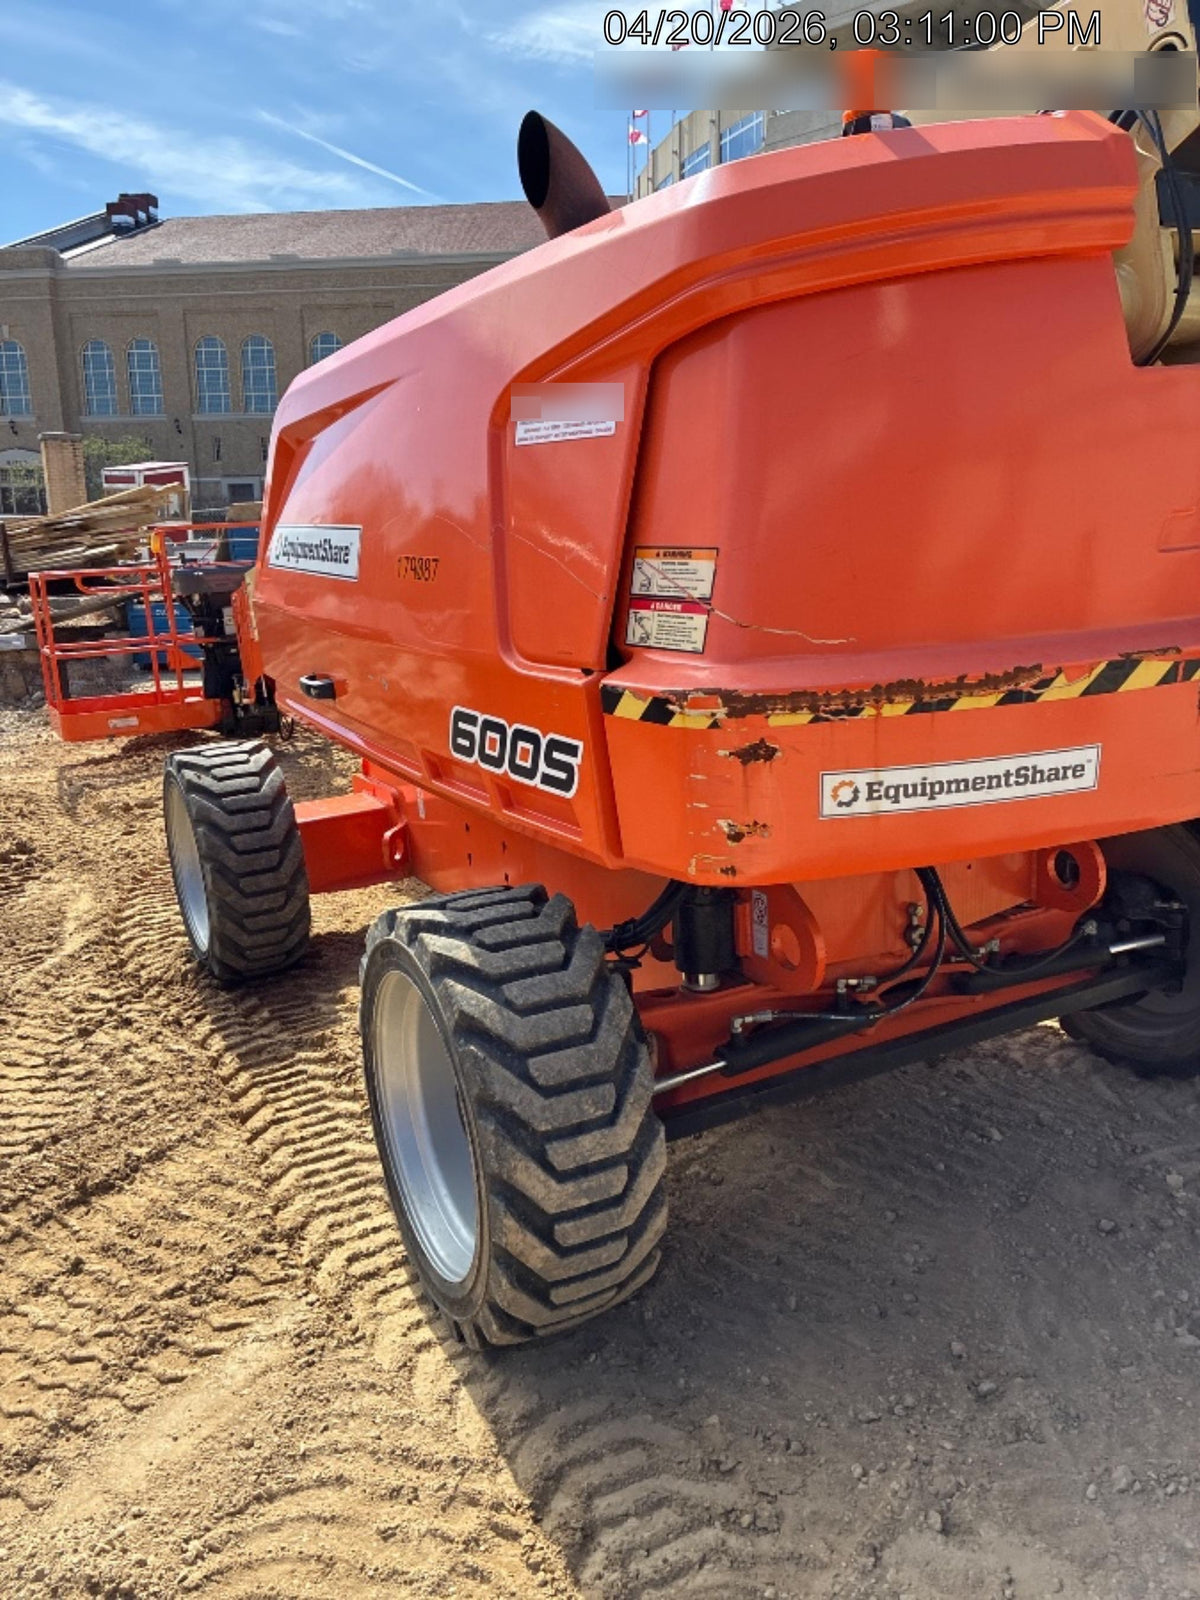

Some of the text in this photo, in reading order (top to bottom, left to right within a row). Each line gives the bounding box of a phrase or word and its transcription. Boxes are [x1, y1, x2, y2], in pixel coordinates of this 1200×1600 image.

[282, 535, 351, 565] EquipmentShare
[449, 705, 584, 799] 600S
[865, 762, 1087, 804] EquipmentShare
